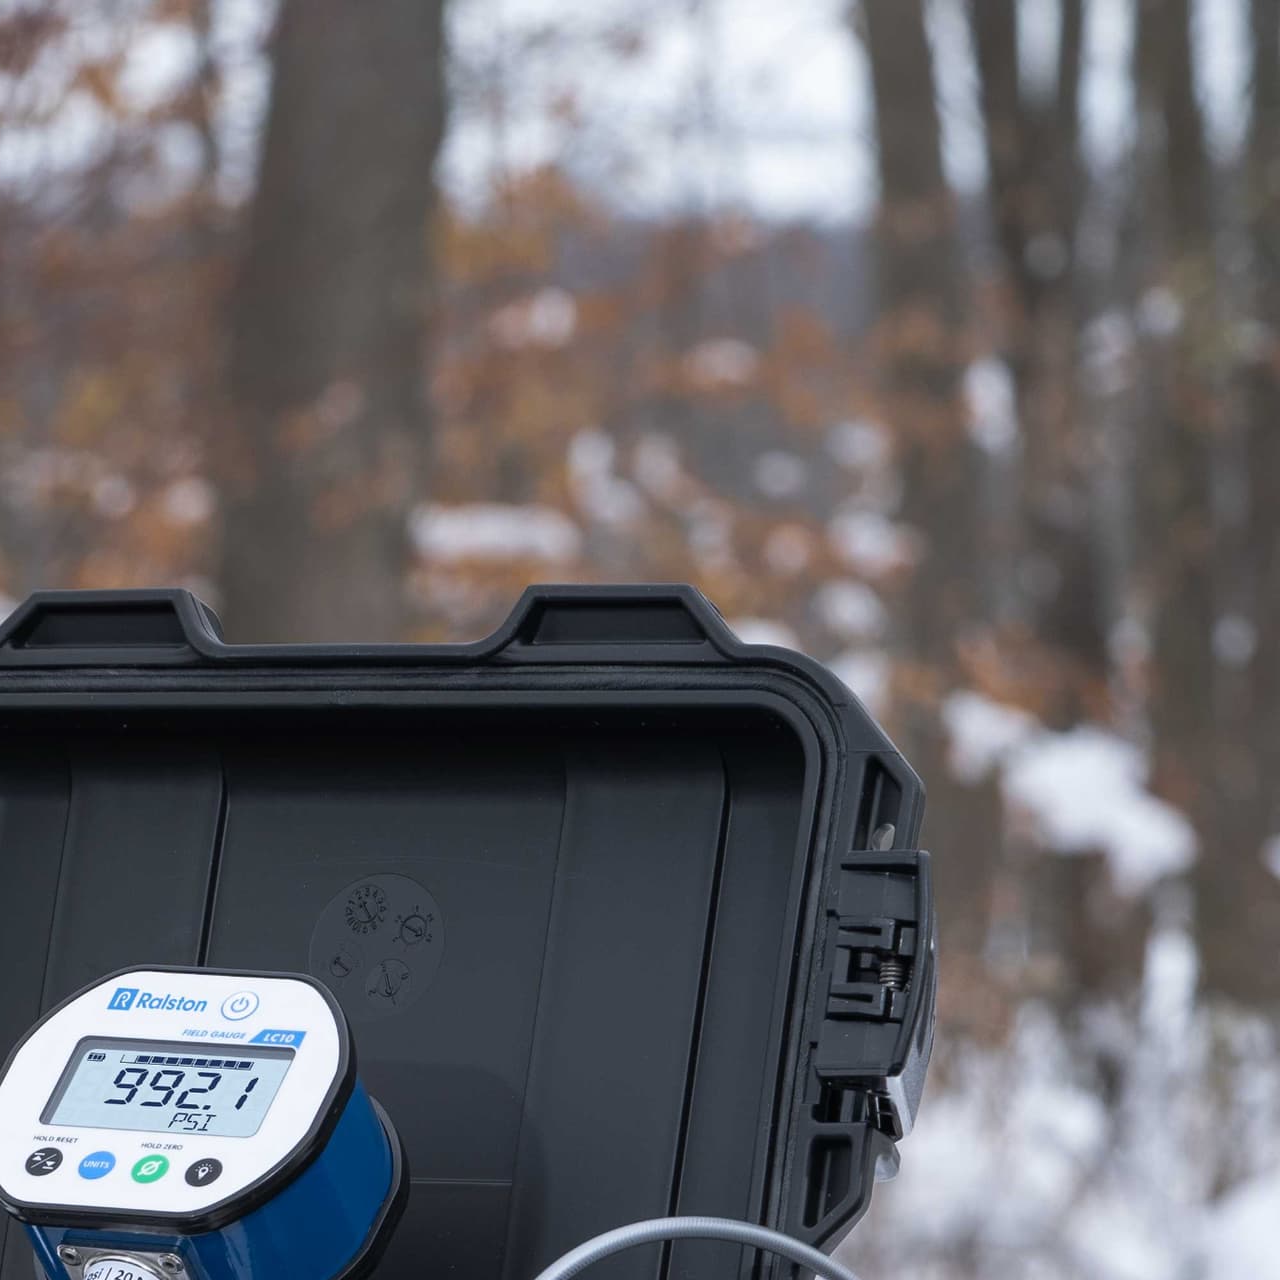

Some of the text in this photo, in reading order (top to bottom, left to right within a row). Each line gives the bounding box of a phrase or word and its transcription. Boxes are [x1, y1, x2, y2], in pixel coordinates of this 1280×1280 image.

[136, 991, 208, 1013] Ralston
[181, 1029, 208, 1038] FIELD
[209, 1031, 246, 1040] GAUGE
[103, 1067, 259, 1110] 992.1
[168, 1112, 217, 1131] PSI
[33, 1134, 80, 1145] HOLD RESET
[140, 1142, 184, 1151] HOLD ZERO
[83, 1159, 111, 1170] UNITS
